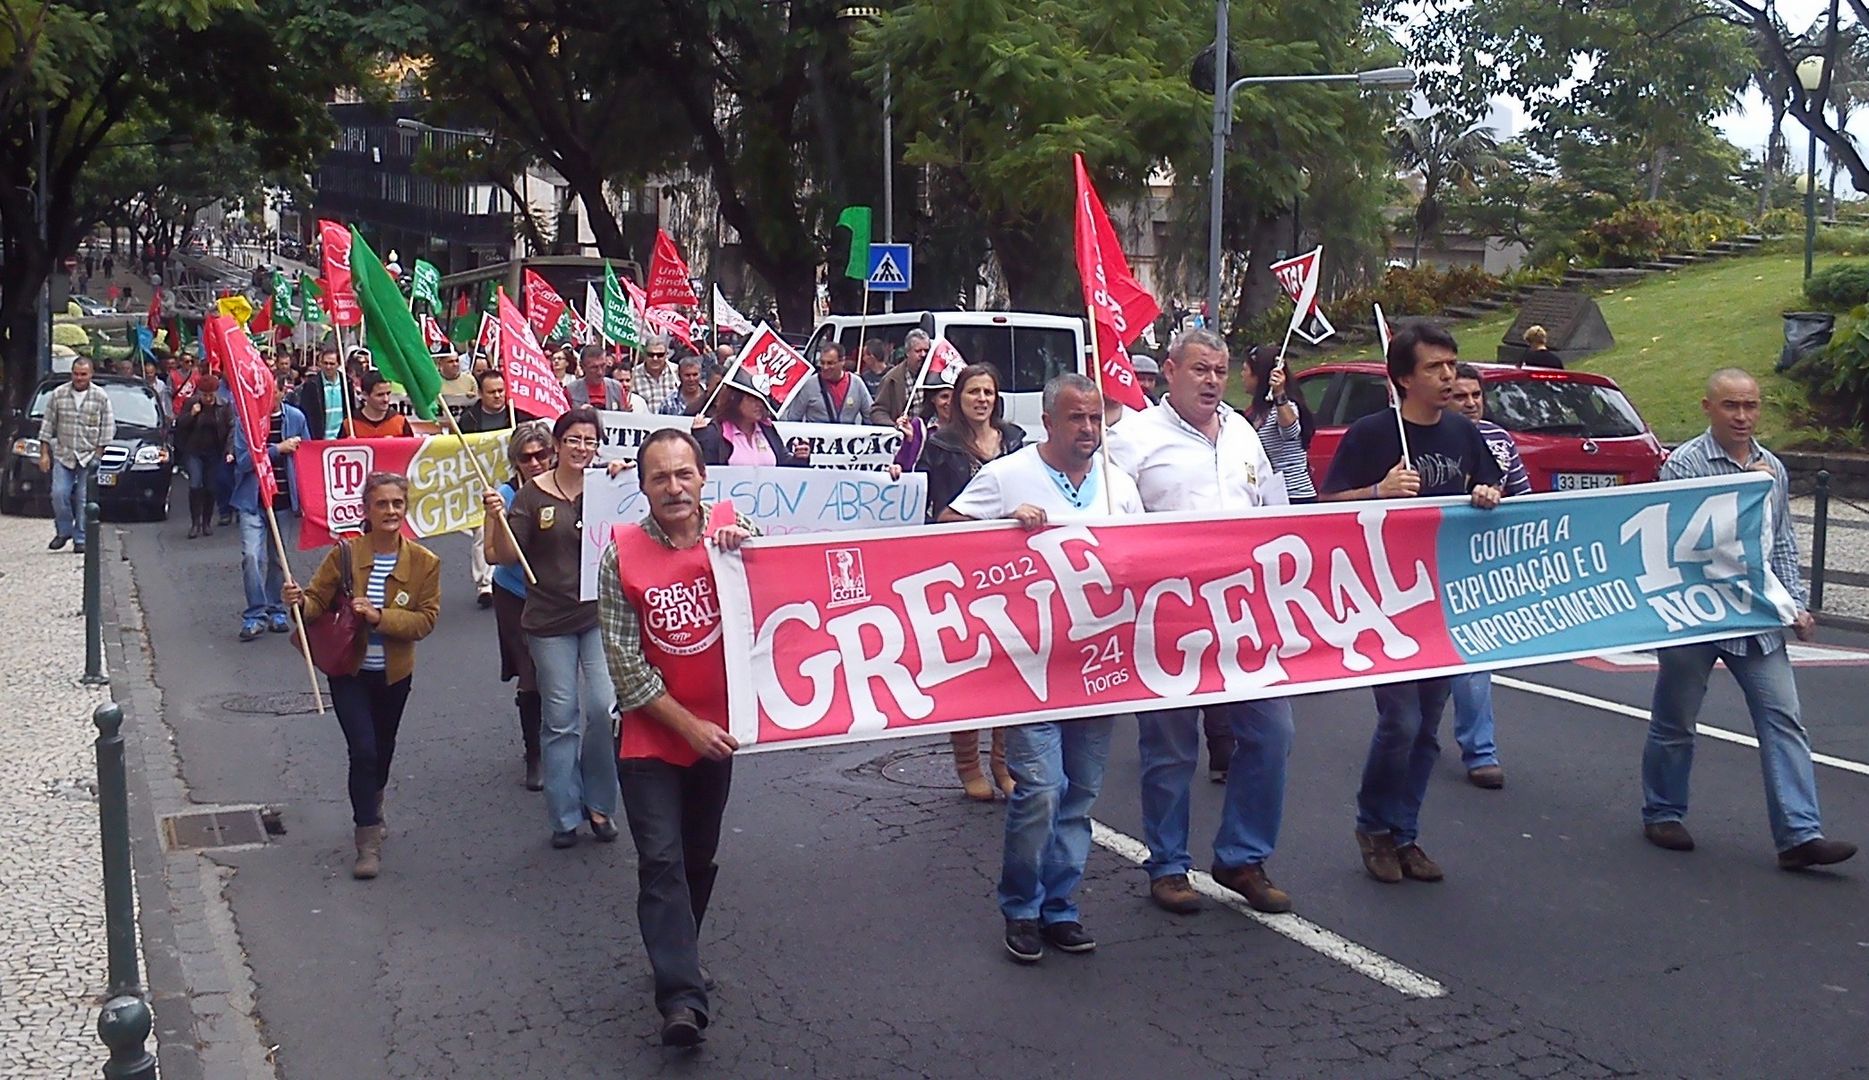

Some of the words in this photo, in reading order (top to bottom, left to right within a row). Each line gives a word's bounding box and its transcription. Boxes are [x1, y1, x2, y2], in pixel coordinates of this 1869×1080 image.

[761, 342, 797, 381] STAL
[332, 454, 363, 495] fp
[817, 481, 920, 522] ABREU
[1470, 517, 1548, 565] CONTRA
[1554, 514, 1571, 541] A
[1620, 491, 1748, 594] 14
[644, 576, 712, 609] GREVE
[834, 587, 864, 600] CGTP
[972, 556, 1038, 590] 2012
[1445, 549, 1572, 615] EXPLORAÇÃO
[1576, 546, 1588, 578] E
[1593, 541, 1608, 574] O
[648, 596, 721, 632] GERAL
[752, 525, 1137, 734] GREVE
[1133, 509, 1436, 698] GERAL
[1451, 578, 1637, 656] EMPOBRECIMENTO
[1647, 580, 1753, 633] NOV
[1080, 634, 1124, 675] 24
[1083, 668, 1130, 697] horas
